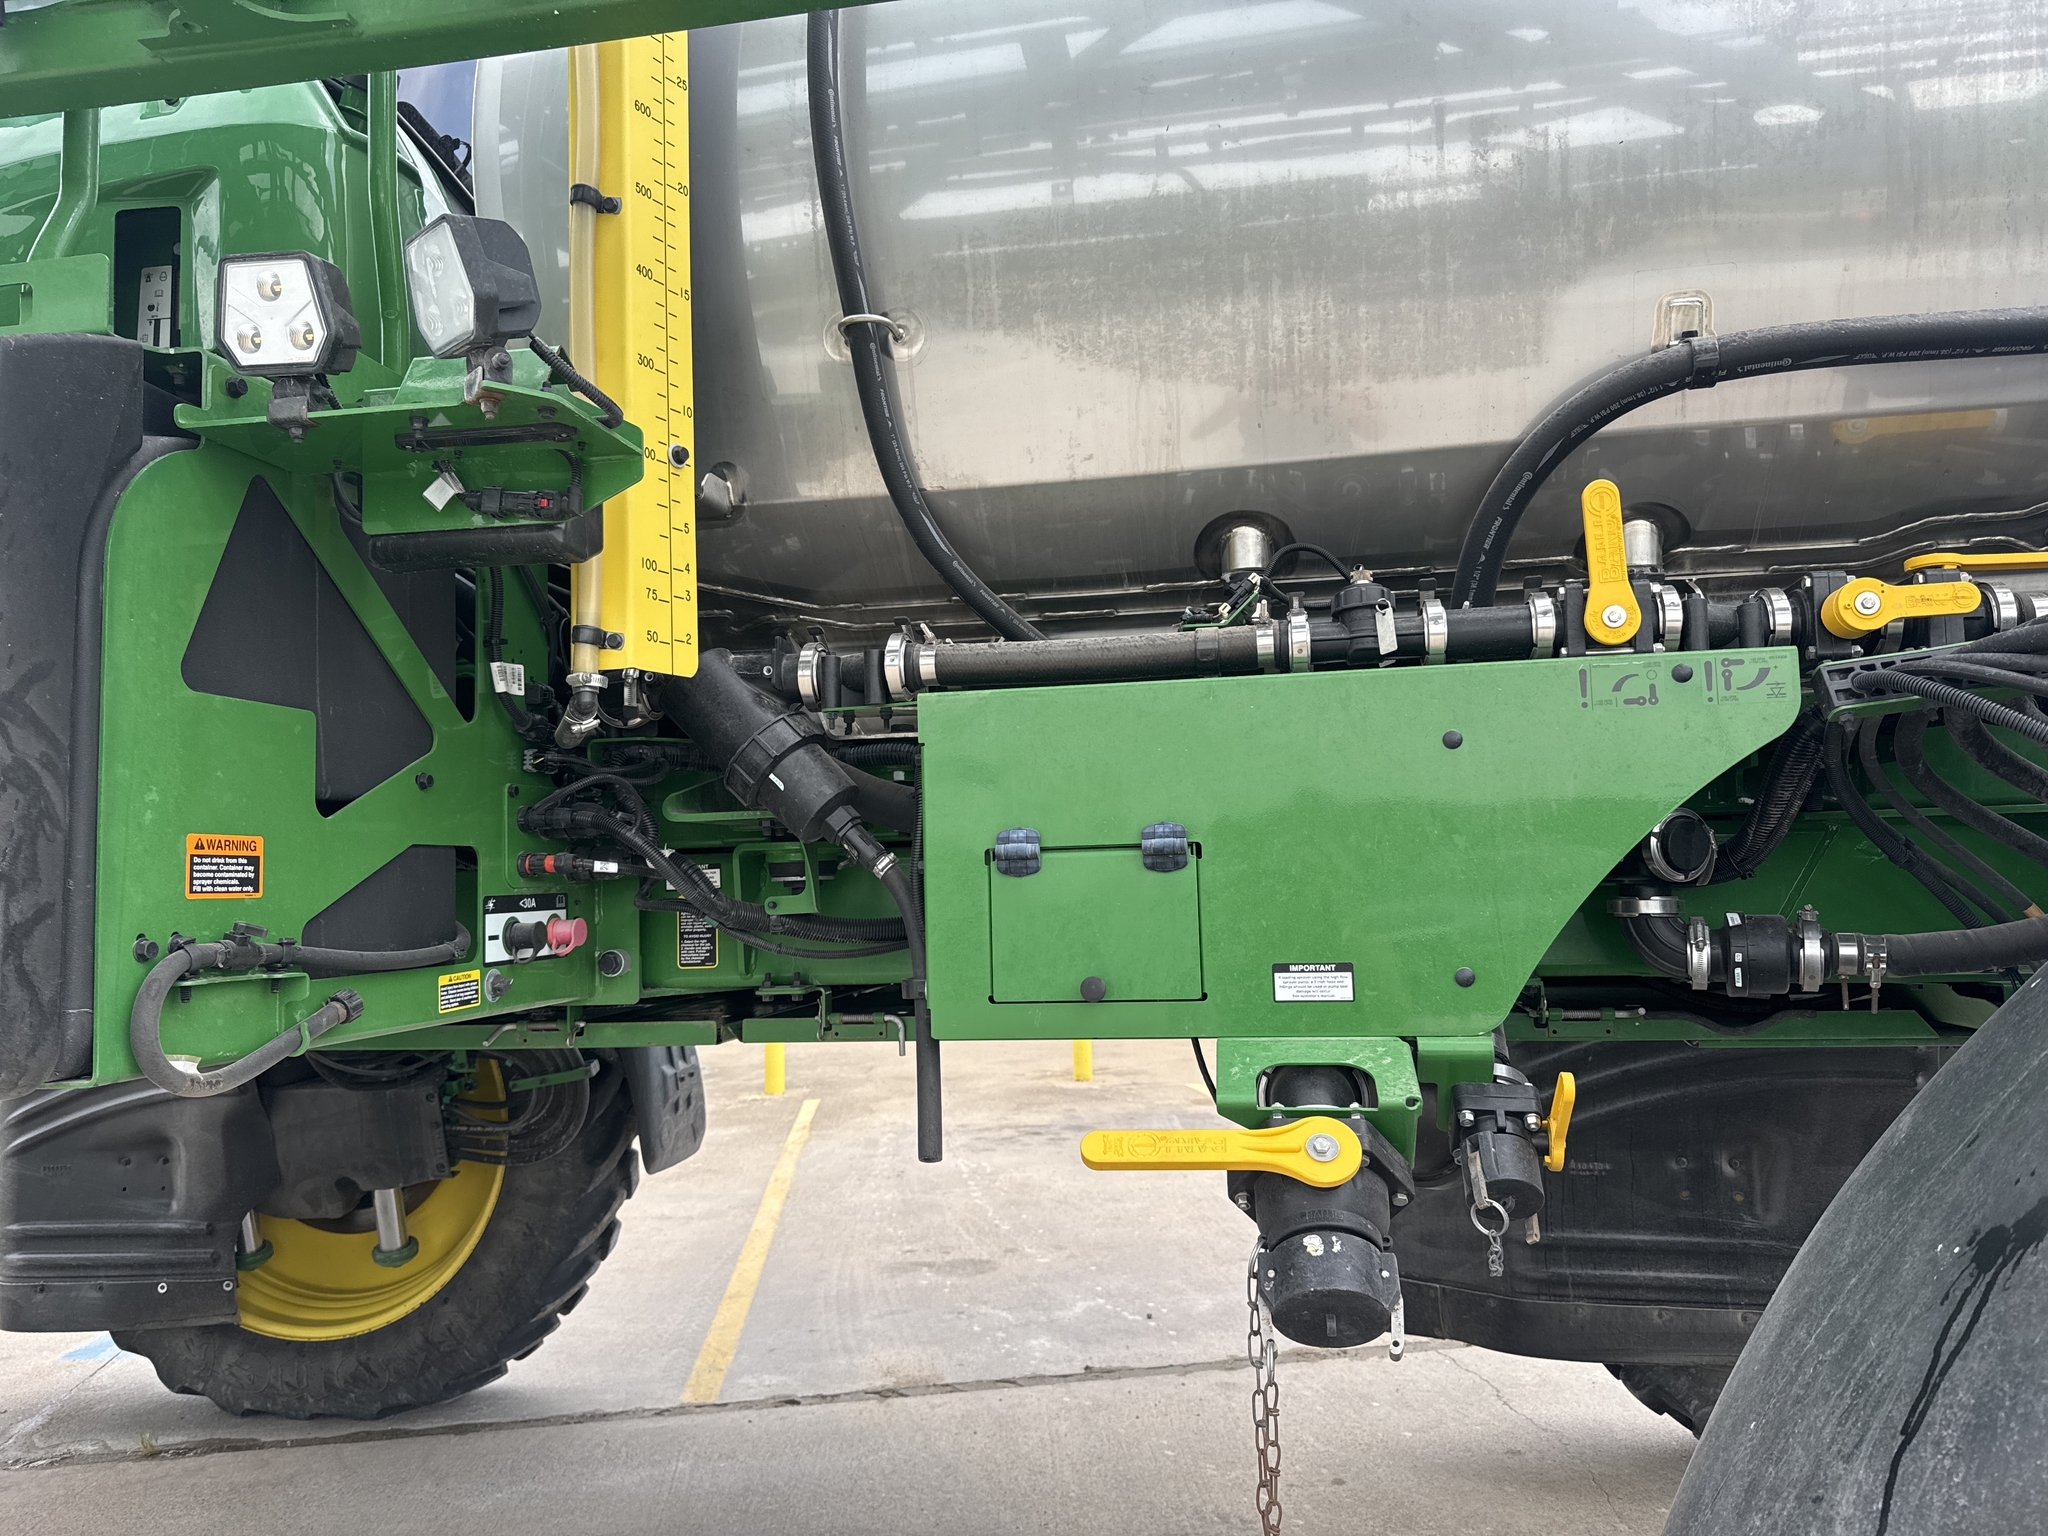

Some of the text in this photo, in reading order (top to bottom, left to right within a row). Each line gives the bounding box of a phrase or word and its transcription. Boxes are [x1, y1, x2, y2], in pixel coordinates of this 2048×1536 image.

[676, 77, 688, 91] 25
[634, 100, 651, 118] 600
[635, 182, 652, 200] 500
[678, 183, 689, 197] 20
[636, 264, 653, 280] 400
[679, 287, 690, 301] 15
[637, 354, 654, 370] 300
[1744, 358, 1792, 371] Continental
[870, 342, 881, 376] Continental
[880, 389, 890, 418] FRONTIER
[682, 406, 692, 418] 10
[1600, 407, 1611, 416] PSI
[1610, 402, 1620, 411] 200
[644, 447, 655, 460] 00
[1506, 471, 1533, 507] Continental
[684, 523, 690, 534] 5
[1483, 516, 1503, 551] FRONTIER
[641, 557, 657, 571] 100
[684, 563, 691, 574] 4
[646, 588, 657, 600] 75
[685, 591, 691, 601] 3
[647, 630, 658, 642] 50
[686, 634, 692, 645] 2
[207, 839, 256, 851] WARNING
